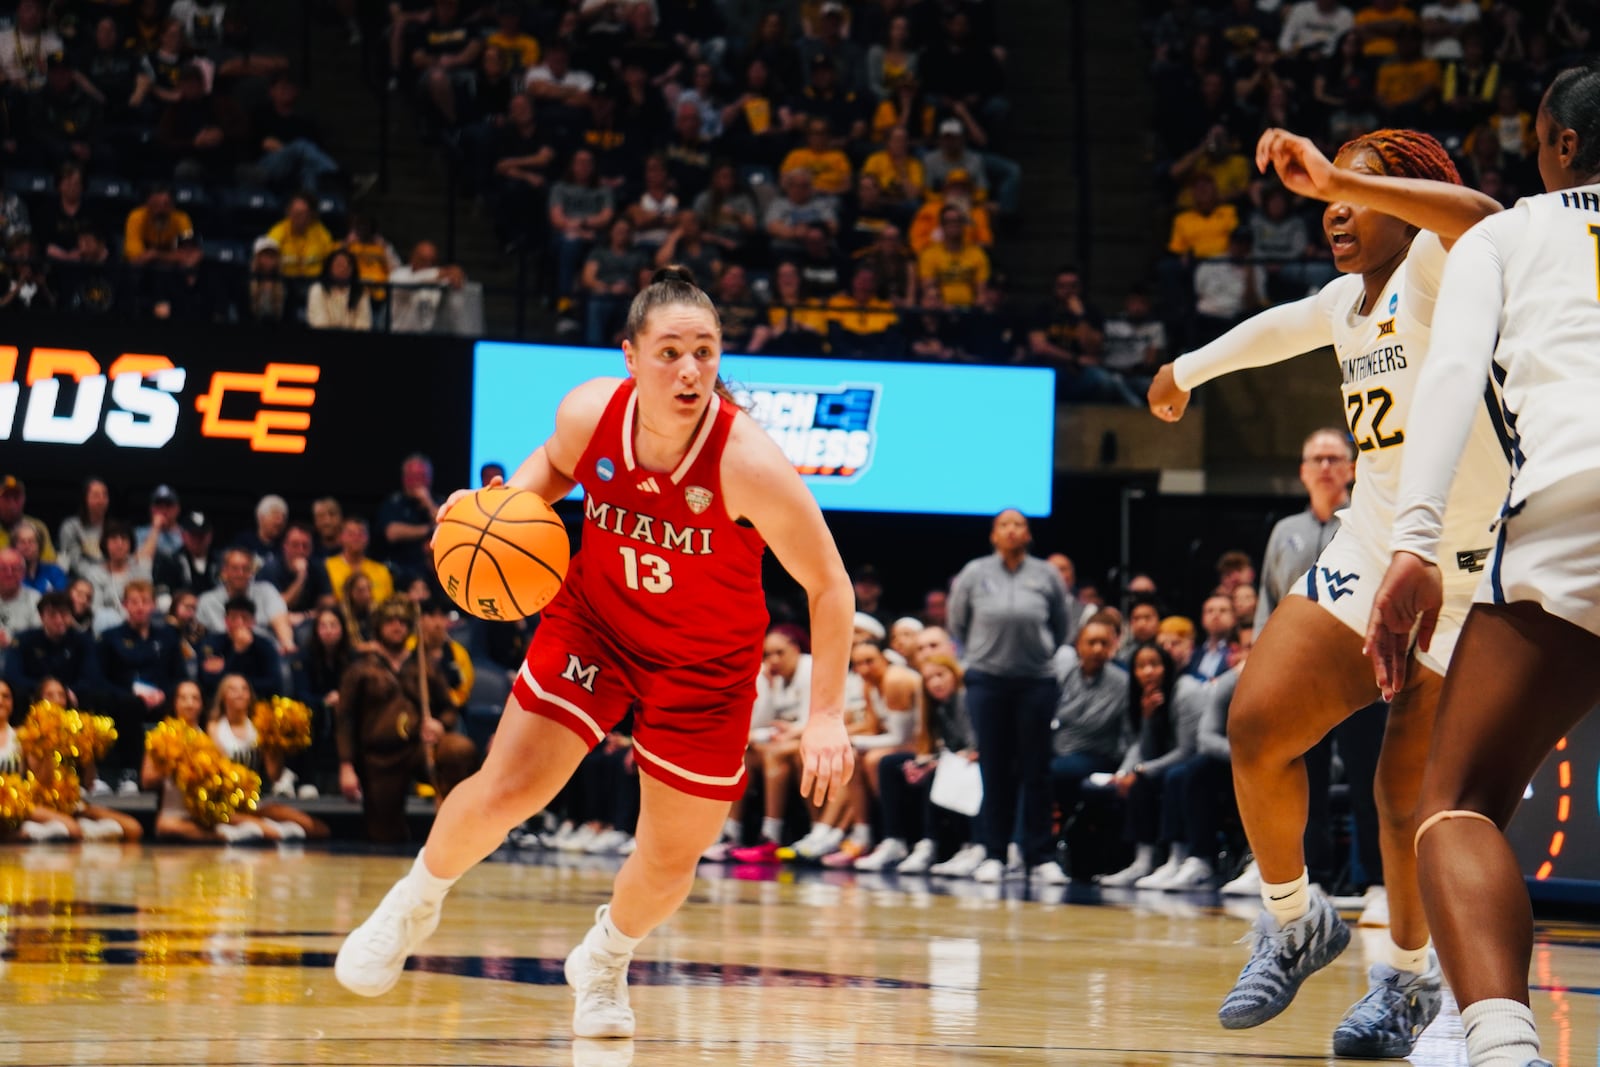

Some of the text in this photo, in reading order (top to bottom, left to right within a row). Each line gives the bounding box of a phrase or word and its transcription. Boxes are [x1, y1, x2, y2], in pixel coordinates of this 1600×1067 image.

[1347, 386, 1406, 452] 22
[584, 493, 713, 556] MIAMI
[618, 545, 675, 594] 13
[560, 652, 601, 696] M
